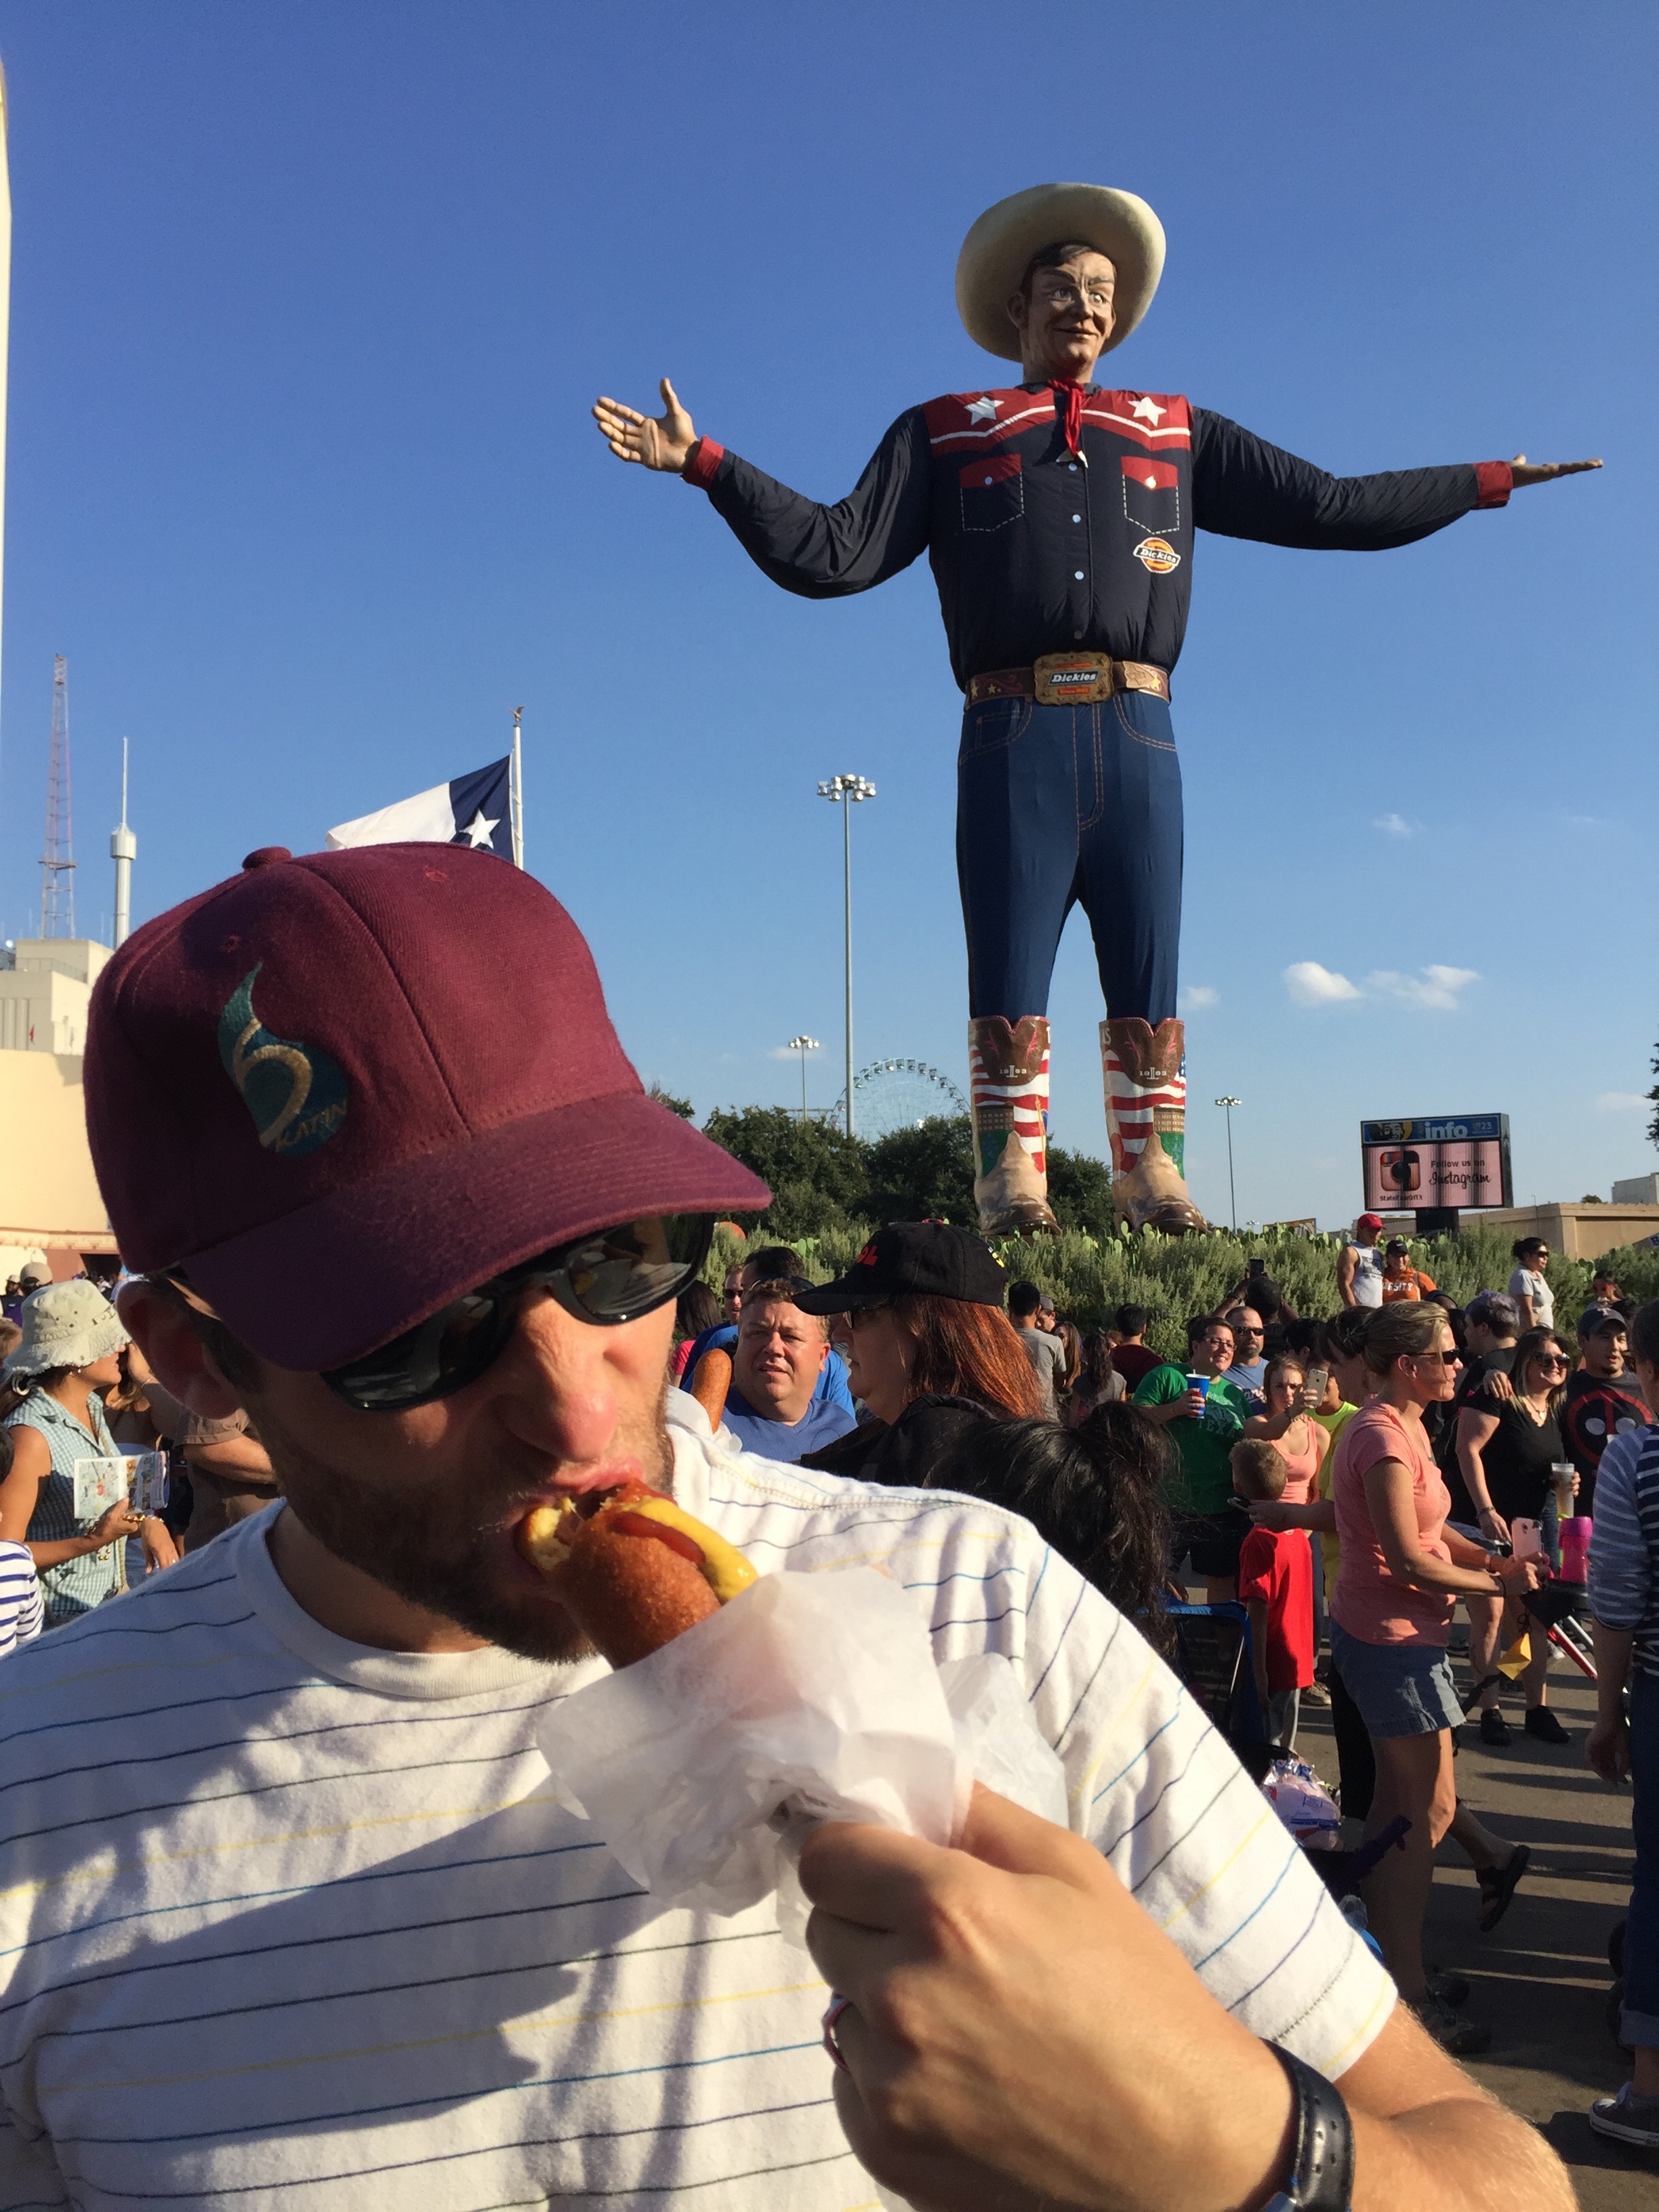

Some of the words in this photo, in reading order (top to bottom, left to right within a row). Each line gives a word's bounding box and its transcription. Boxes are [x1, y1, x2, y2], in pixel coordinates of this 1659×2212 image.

[1139, 548, 1176, 563] Dickies
[1051, 673, 1097, 682] Dickies
[1425, 1122, 1468, 1139] info
[1429, 1171, 1490, 1189] Instagram
